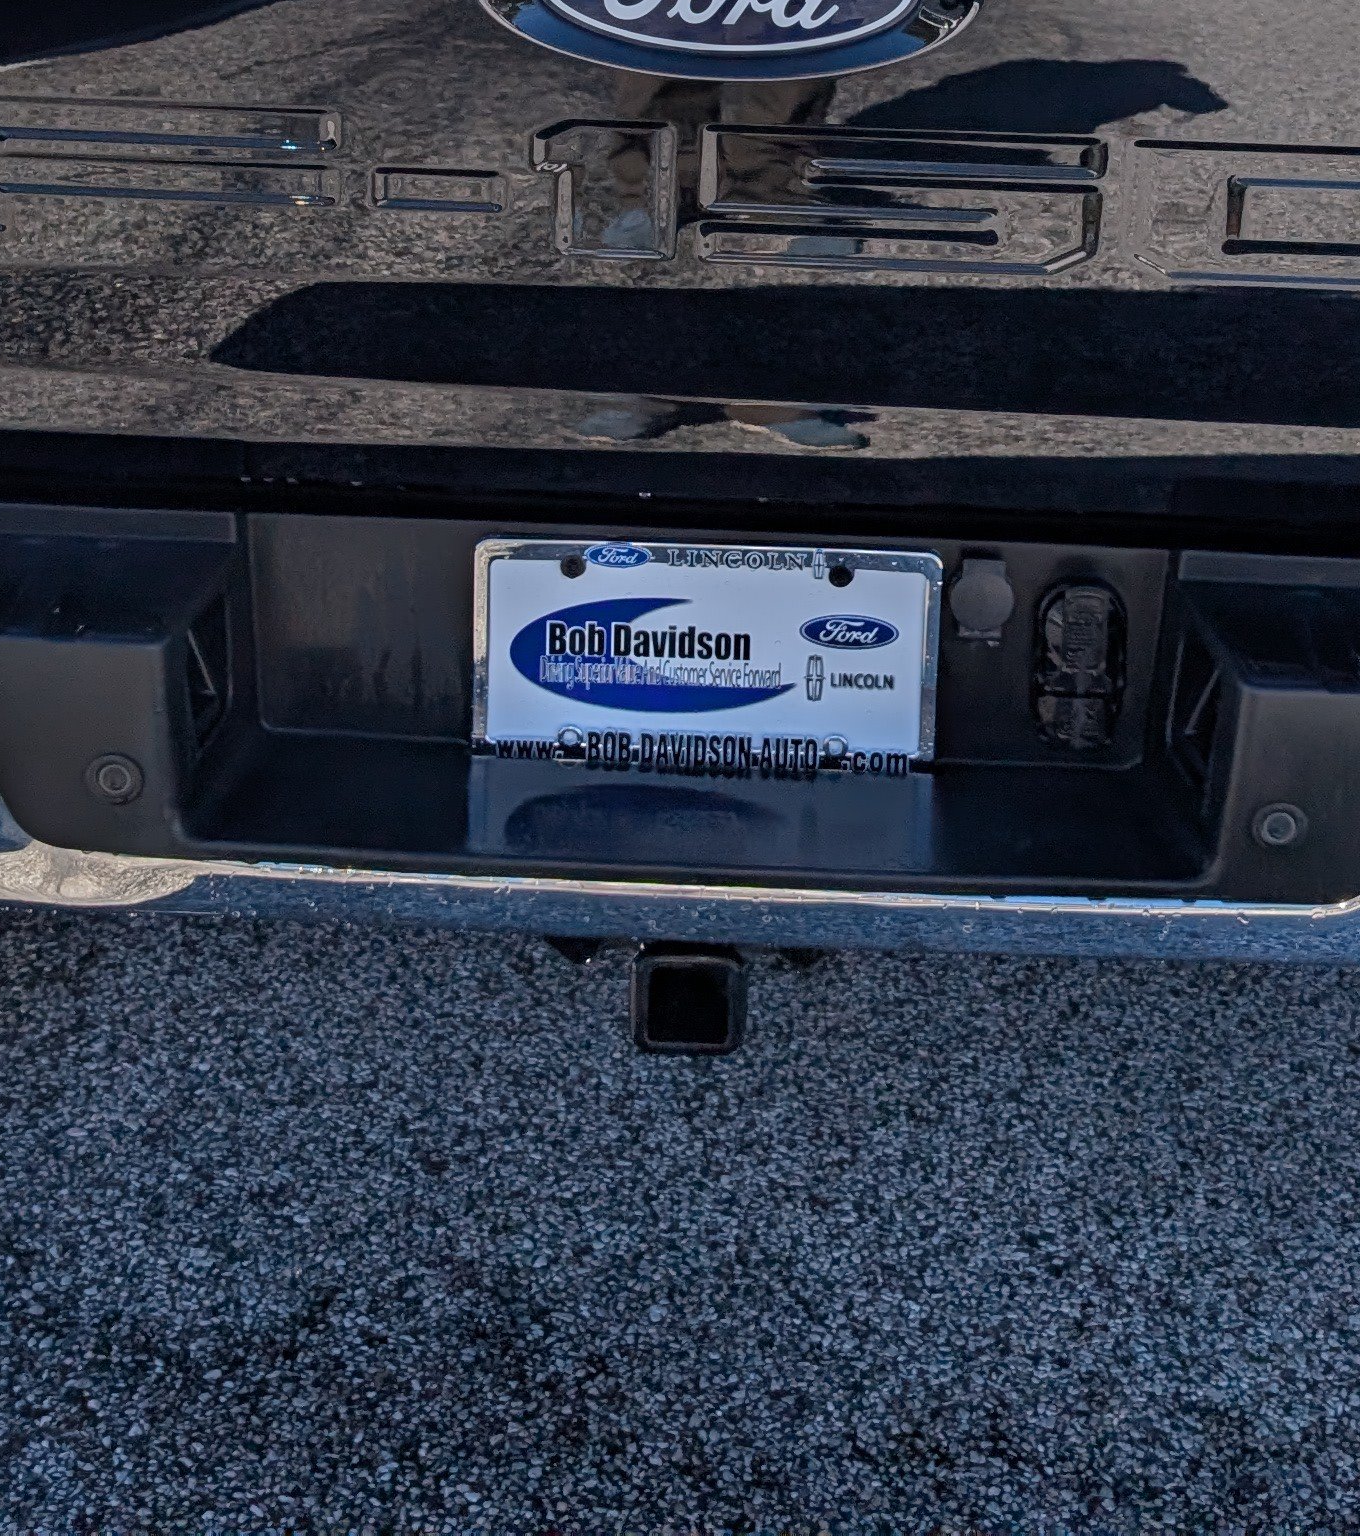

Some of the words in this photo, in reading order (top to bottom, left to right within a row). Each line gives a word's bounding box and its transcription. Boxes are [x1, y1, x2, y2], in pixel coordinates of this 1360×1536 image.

[667, 548, 808, 571] LINCOLN
[546, 620, 606, 658] Bob
[611, 622, 752, 661] Davidson
[662, 660, 707, 687] Customer
[709, 661, 742, 688] Service
[743, 662, 782, 689] Forward
[830, 672, 895, 690] LINCOLN
